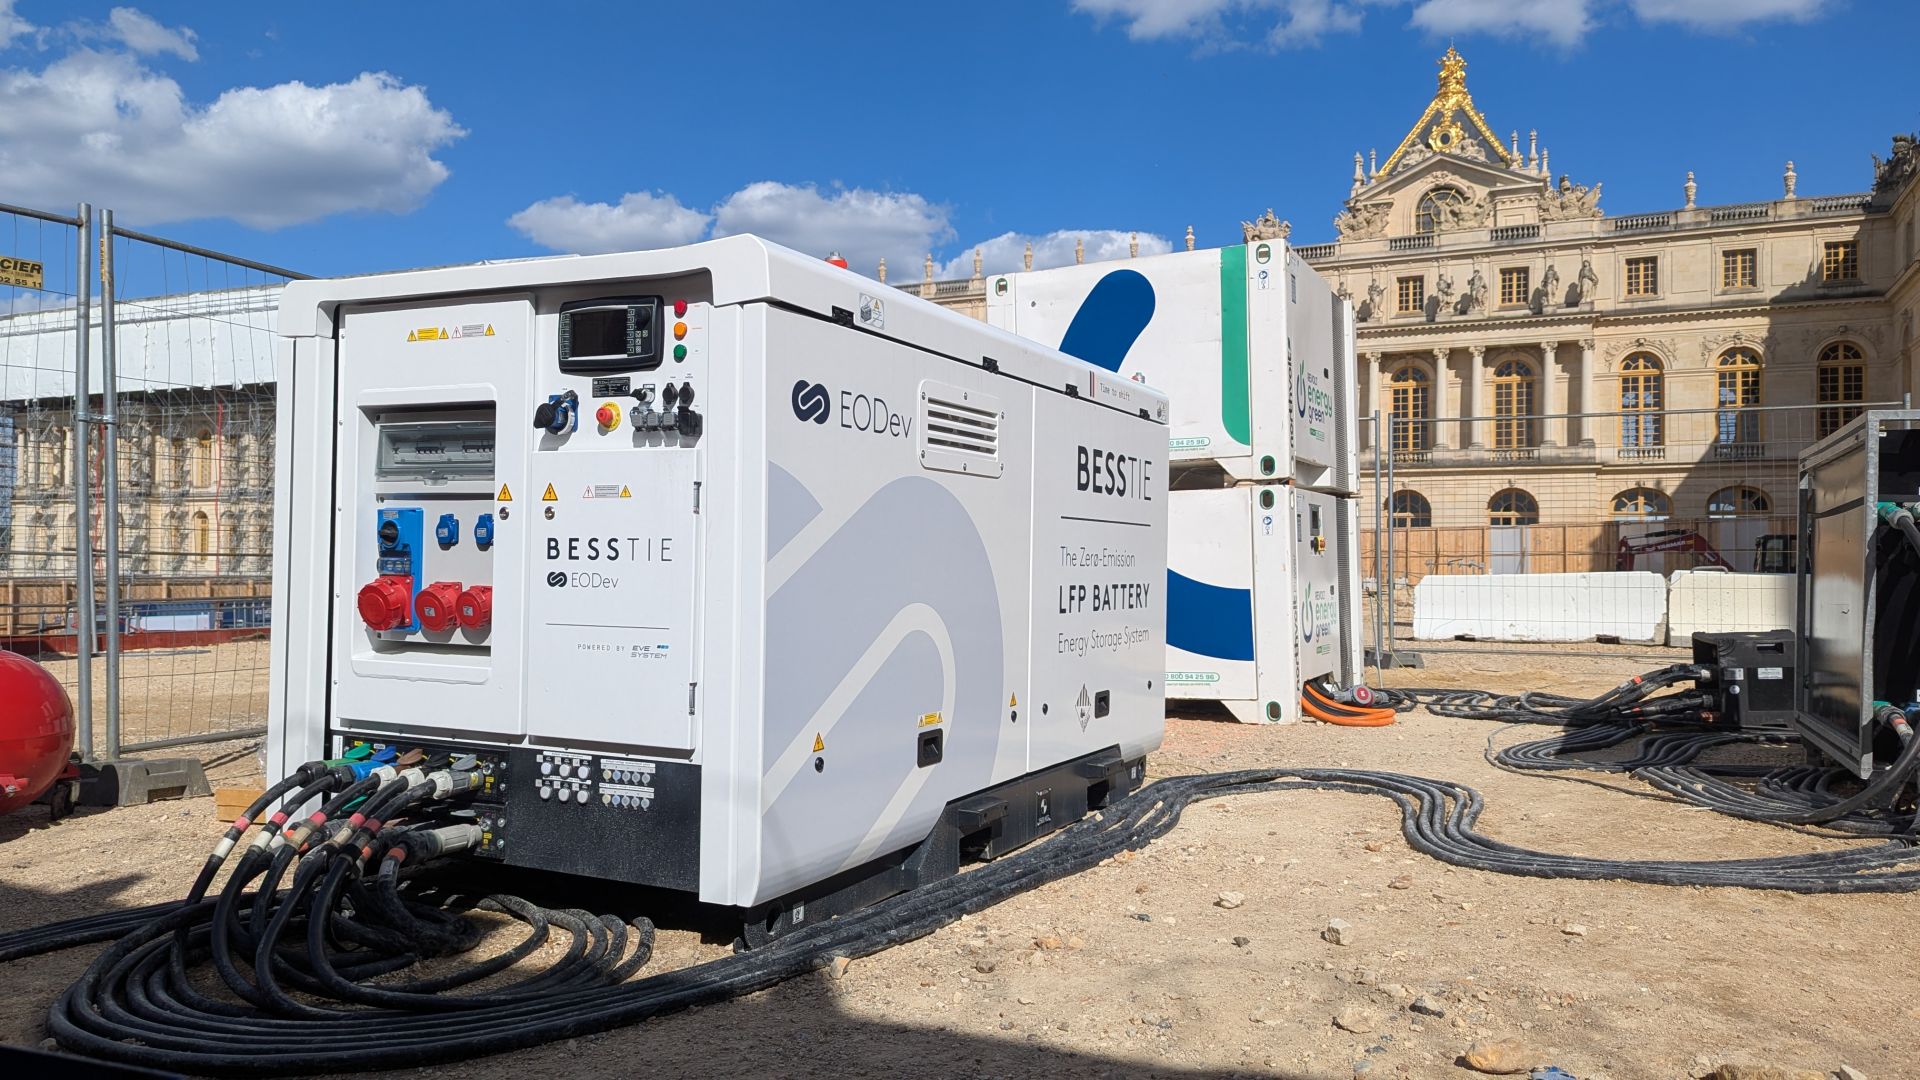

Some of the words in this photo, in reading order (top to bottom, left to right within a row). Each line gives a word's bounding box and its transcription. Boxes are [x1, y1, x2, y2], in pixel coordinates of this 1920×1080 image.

[32, 281, 42, 289] 11
[1099, 382, 1110, 395] Time
[1119, 390, 1131, 402] shift
[1307, 385, 1333, 417] energy
[840, 390, 913, 439] EODev
[1308, 405, 1325, 424] green
[1077, 445, 1152, 501] BESSTIE
[546, 537, 673, 562] BESSTIE
[1060, 546, 1077, 567] The
[571, 572, 619, 589] EODev
[1058, 584, 1086, 614] LFP
[1092, 582, 1151, 612] BATTERY
[1315, 602, 1337, 625] energy
[1058, 632, 1089, 657] Energy
[1091, 629, 1123, 653] Storage
[1123, 627, 1150, 650] System
[1315, 622, 1331, 643] green
[577, 643, 611, 652] POWERED
[630, 651, 668, 659] SYSTEM
